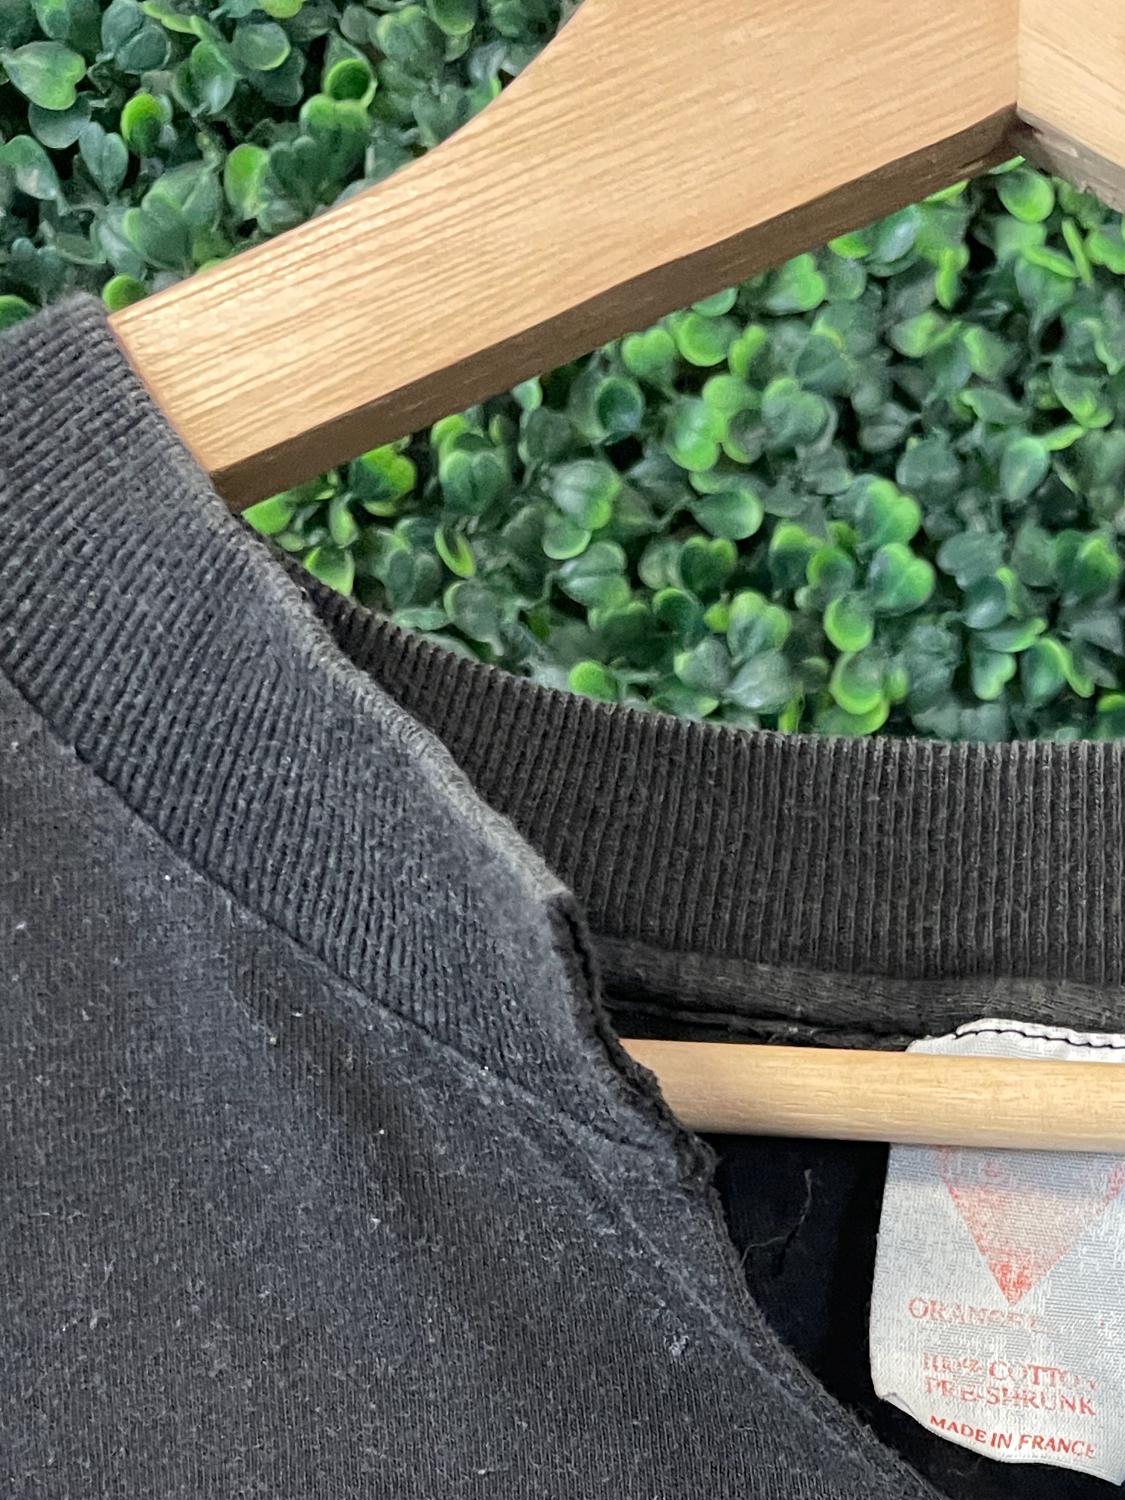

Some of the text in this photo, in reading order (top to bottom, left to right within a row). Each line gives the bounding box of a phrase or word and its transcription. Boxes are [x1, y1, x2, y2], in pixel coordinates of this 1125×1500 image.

[930, 1415, 1097, 1460] MADE IN FRANCE
